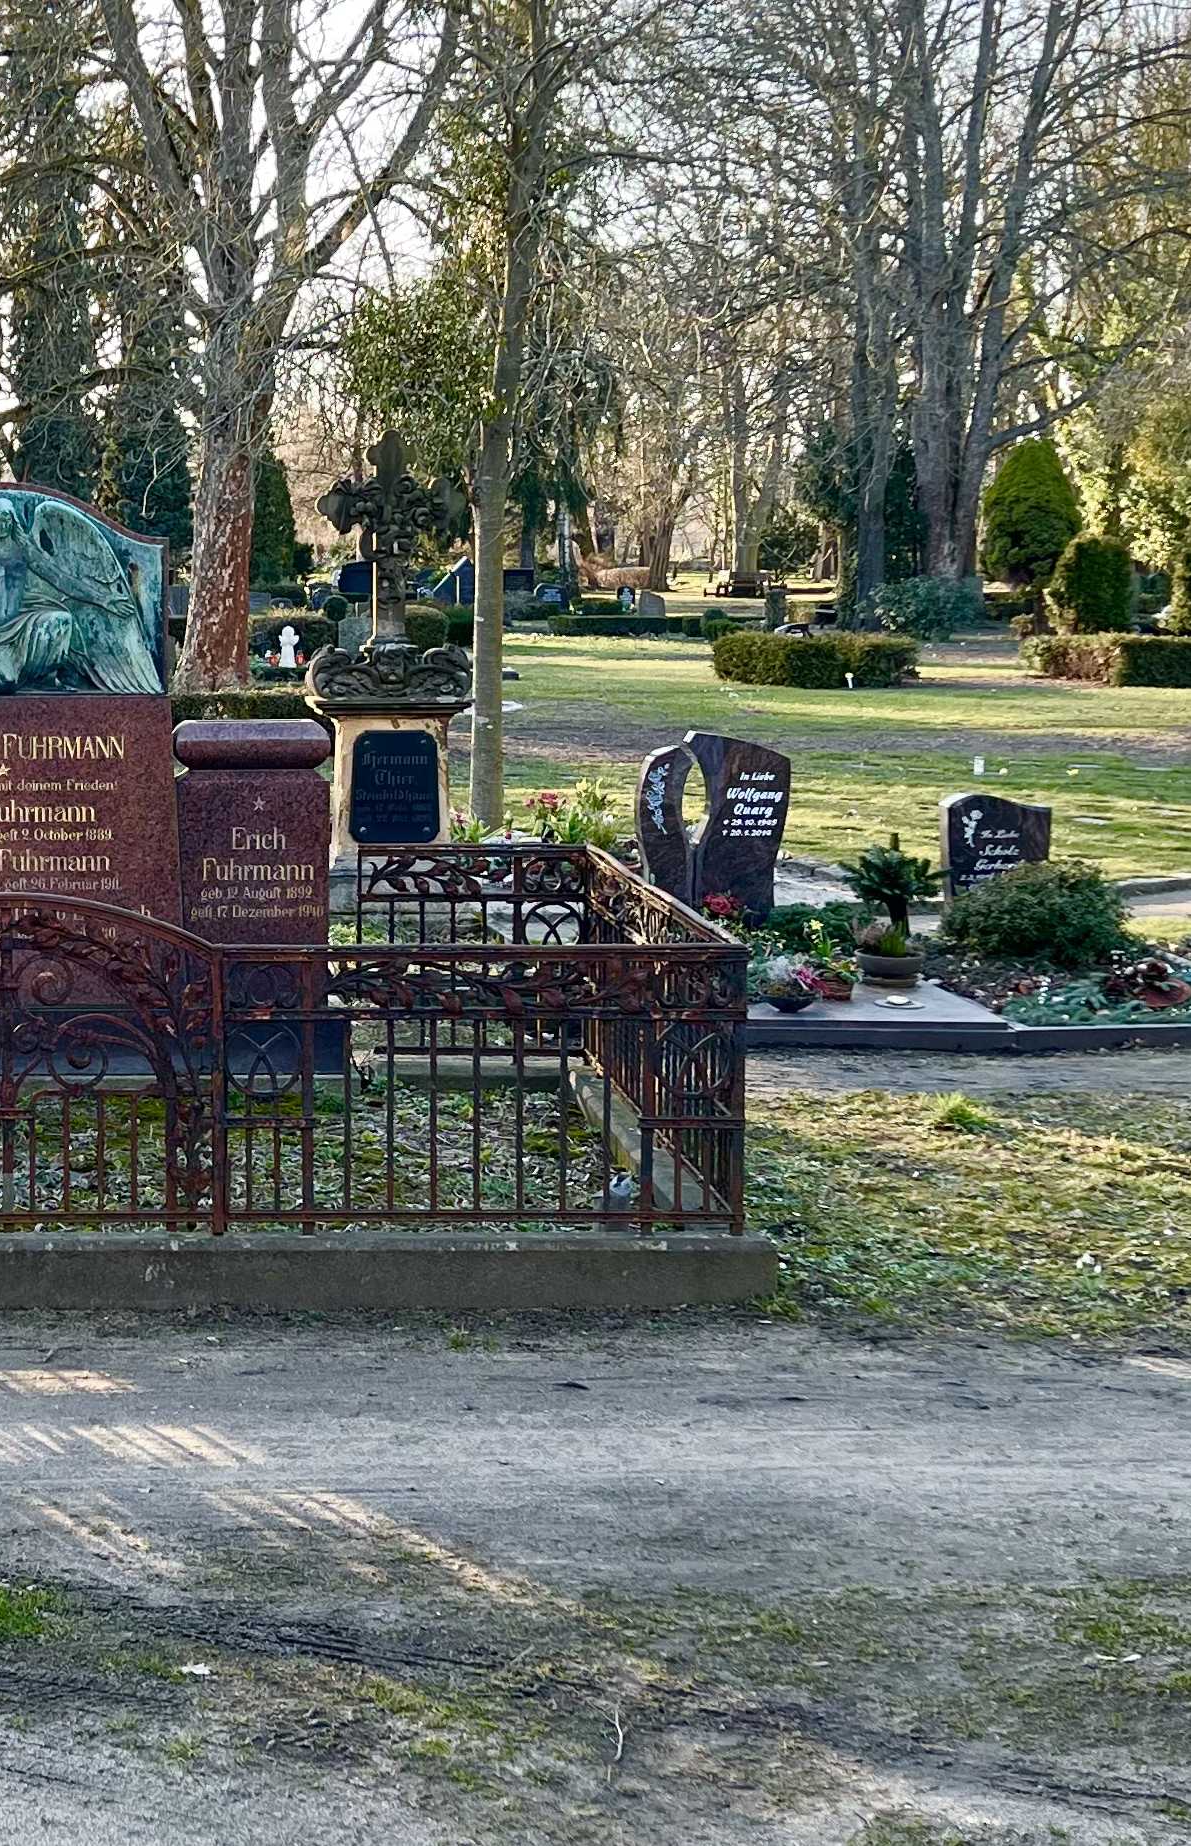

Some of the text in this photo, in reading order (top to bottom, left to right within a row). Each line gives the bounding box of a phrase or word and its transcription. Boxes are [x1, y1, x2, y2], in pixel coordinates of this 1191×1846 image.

[3, 734, 124, 760] FUHRMANN
[739, 771, 776, 780] In Liebe
[726, 787, 784, 803] Wolfgang
[733, 803, 774, 819] Quarg
[33, 828, 83, 841] October
[232, 827, 286, 850] Erich
[978, 845, 1020, 857] Scholz
[202, 858, 315, 881] Fuhrmann
[49, 877, 99, 890] Februar
[232, 904, 296, 918] Dezember
